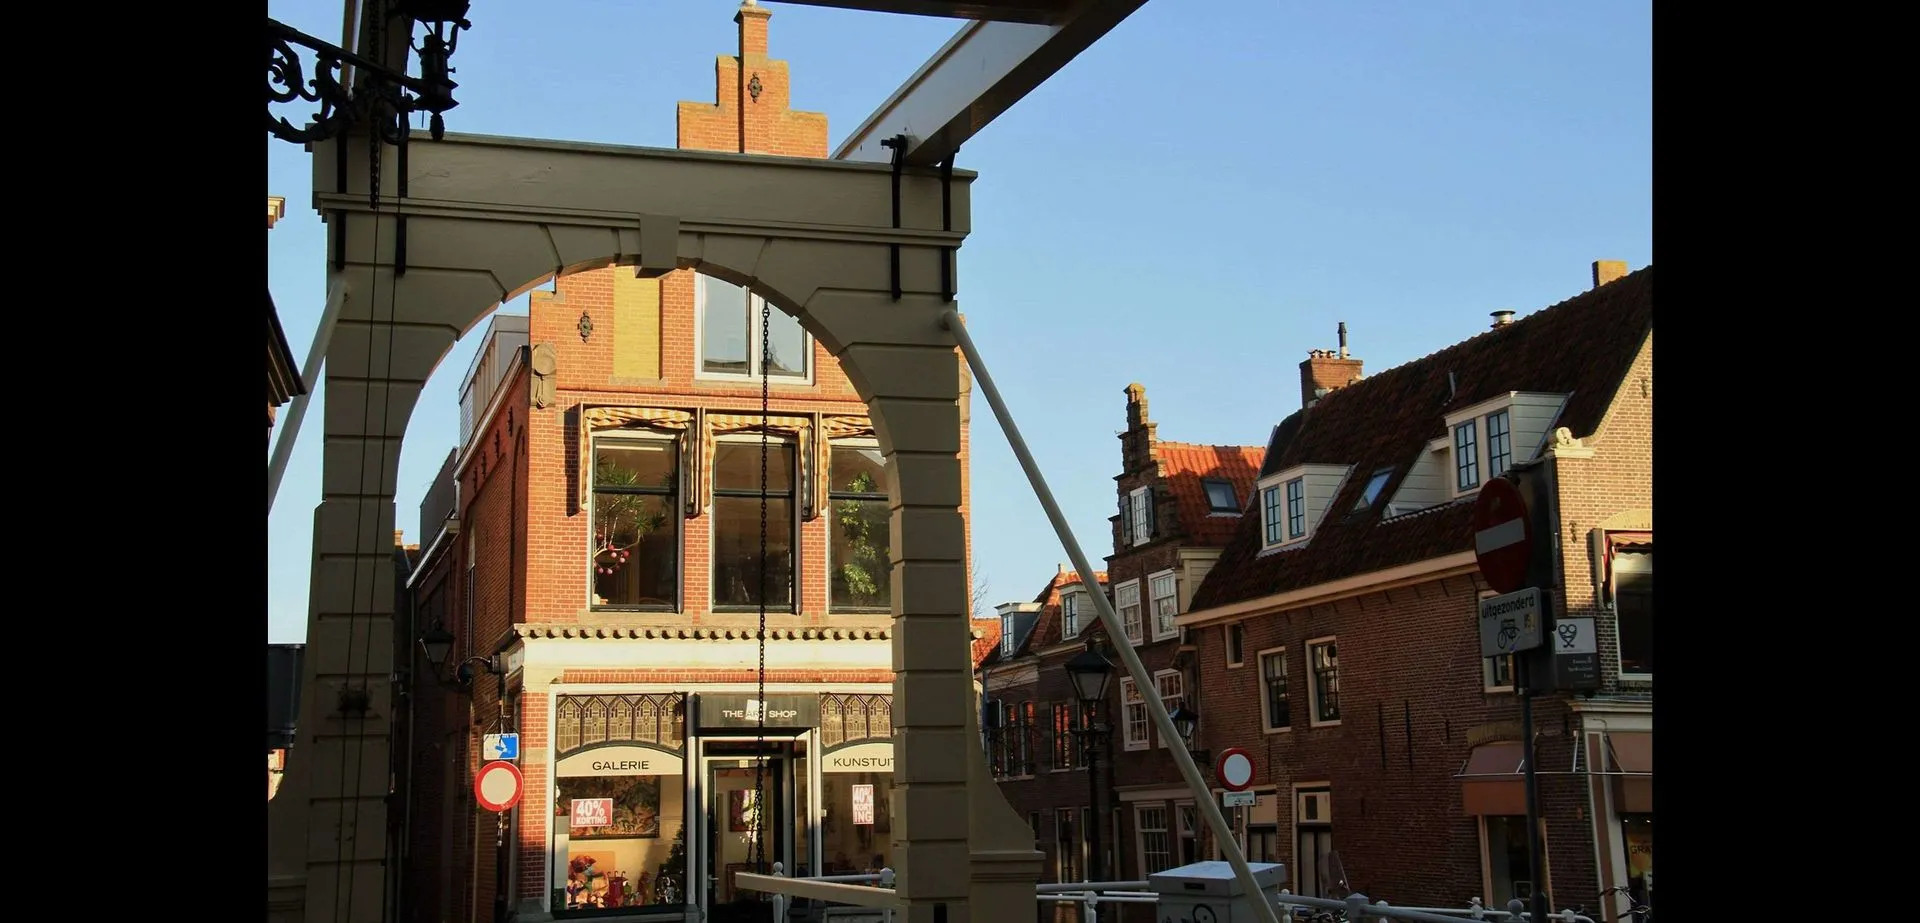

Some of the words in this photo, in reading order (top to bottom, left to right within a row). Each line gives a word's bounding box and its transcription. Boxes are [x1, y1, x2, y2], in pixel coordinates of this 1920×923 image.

[1482, 594, 1535, 620] uitgezonderd
[722, 710, 744, 718] THE
[768, 710, 797, 718] SHOP
[592, 760, 649, 771] GALERIE
[576, 800, 605, 817] 40%
[576, 816, 608, 825] KORTING
